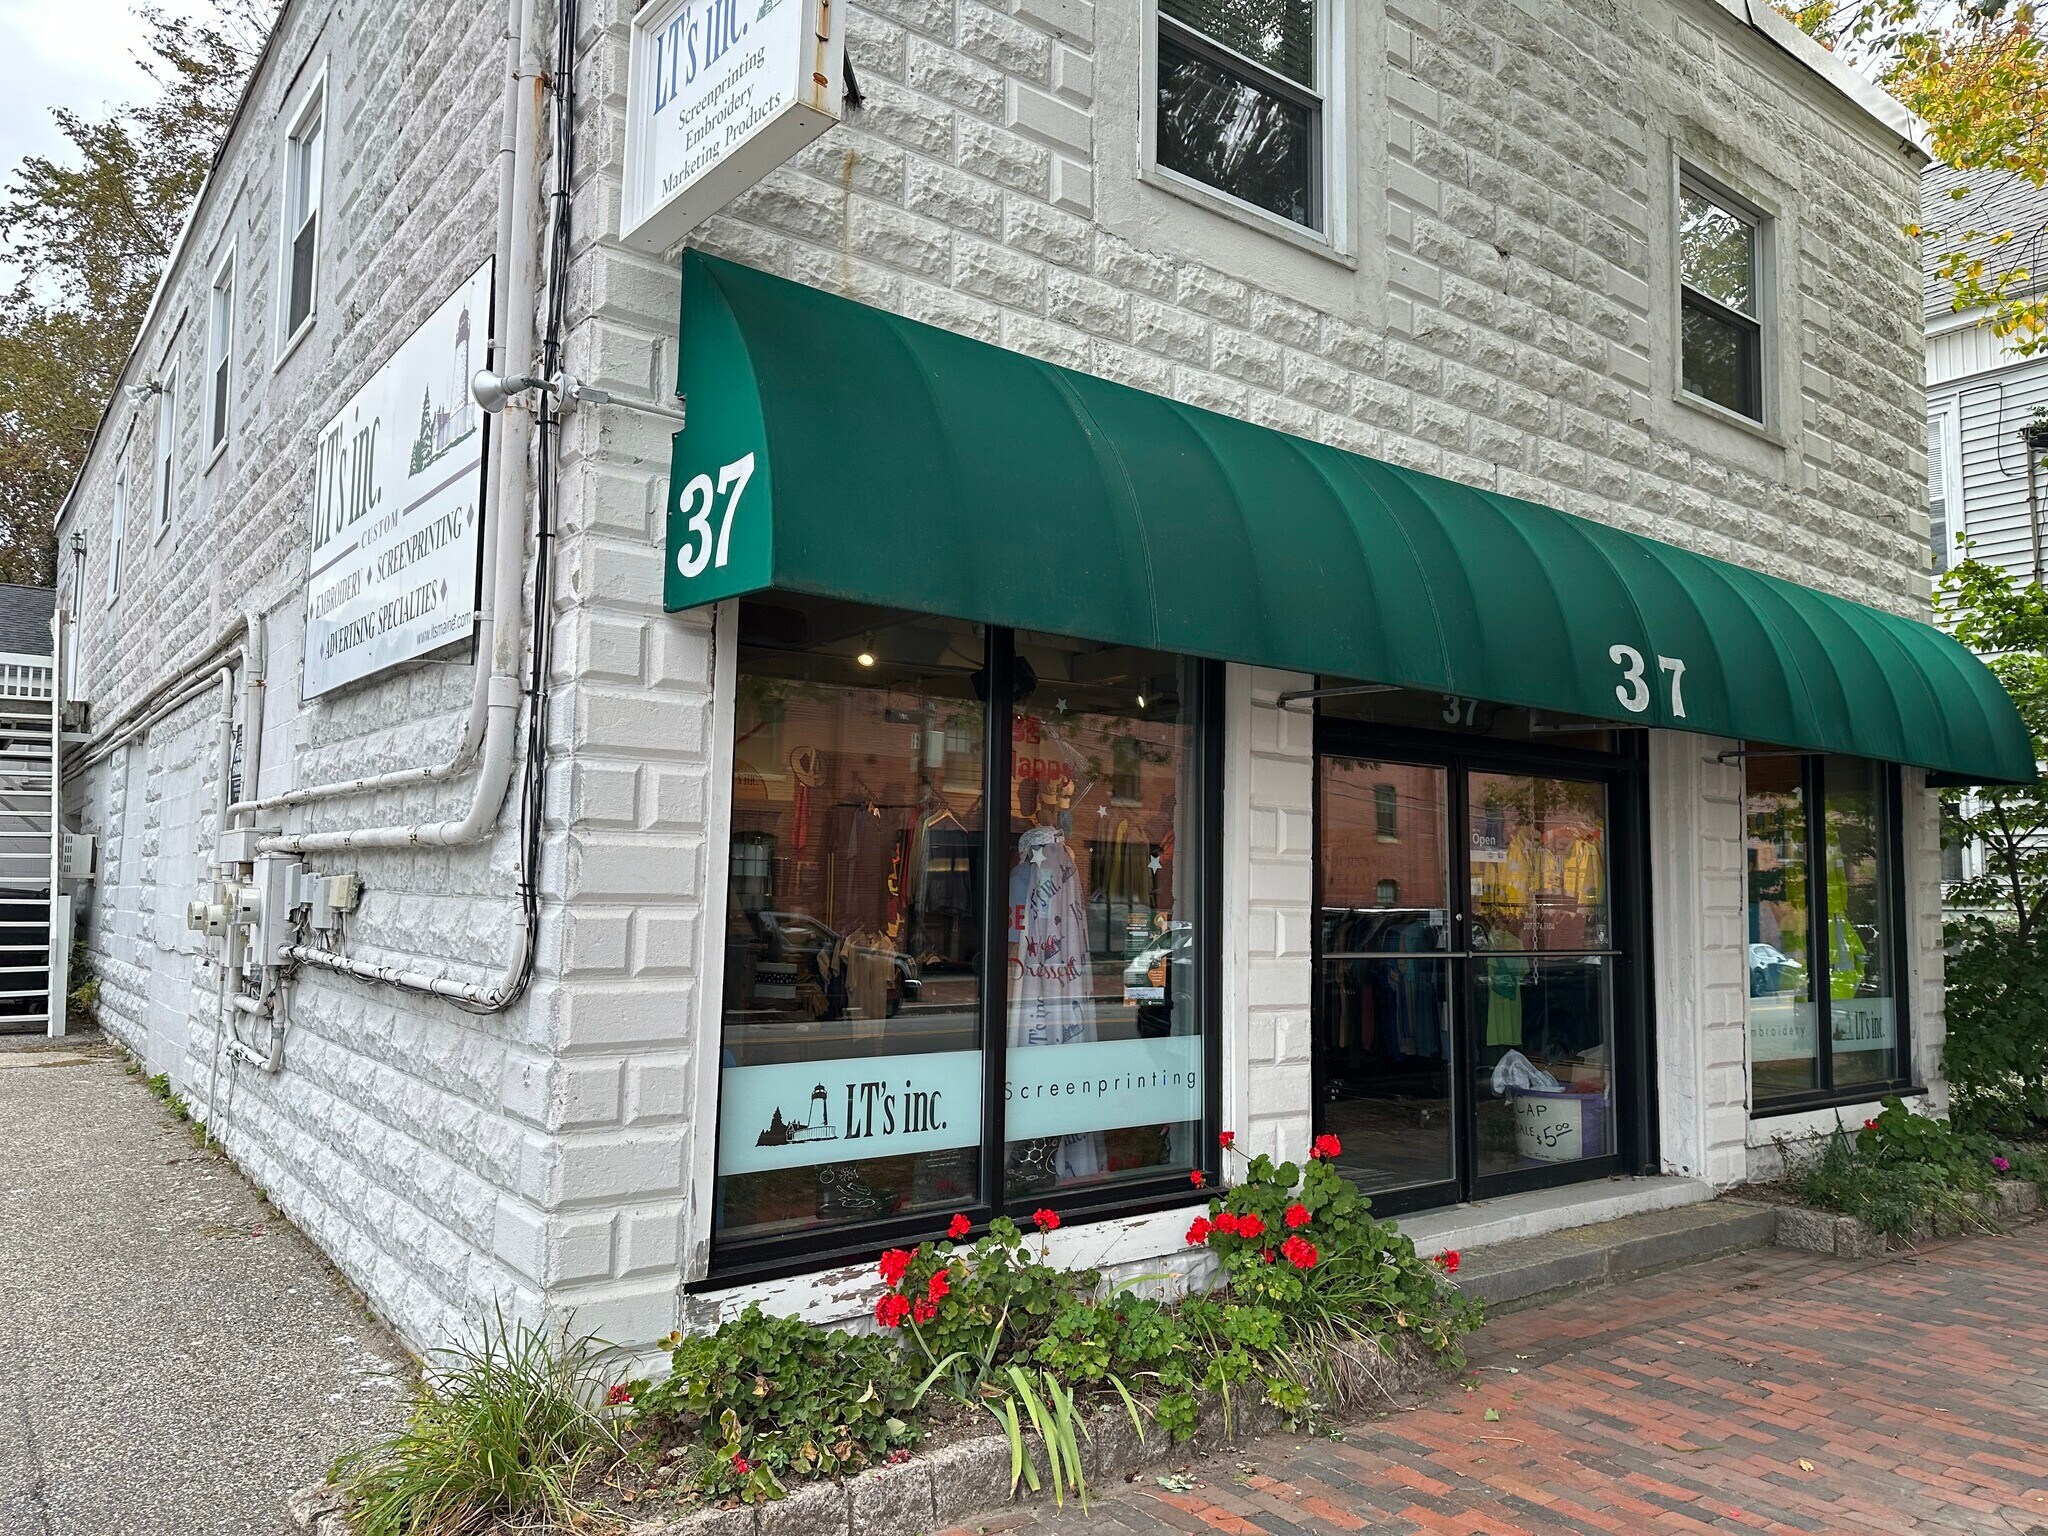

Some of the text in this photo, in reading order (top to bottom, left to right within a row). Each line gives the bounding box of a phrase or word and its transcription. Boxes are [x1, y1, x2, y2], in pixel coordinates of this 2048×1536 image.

[653, 5, 698, 117] LT's
[679, 46, 766, 131] Screenprinting
[661, 92, 781, 198] Marketing Products
[685, 83, 755, 152] Embroidery
[313, 405, 382, 553] LT's inc.
[677, 451, 755, 578] 37
[315, 506, 462, 620] EMBROIDERY SCREENPRINTING
[361, 507, 399, 549] CUSTOM
[325, 579, 438, 660] ADVERTISING SPECIALTIES
[1442, 695, 1480, 726] 37
[1608, 644, 1687, 719] 37
[1472, 833, 1496, 847] Open
[1855, 1011, 1886, 1040] LT's inc.
[844, 1080, 947, 1139] LT's inc.
[1005, 1070, 1197, 1101] Screenprinting
[1516, 1095, 1547, 1117] CAP
